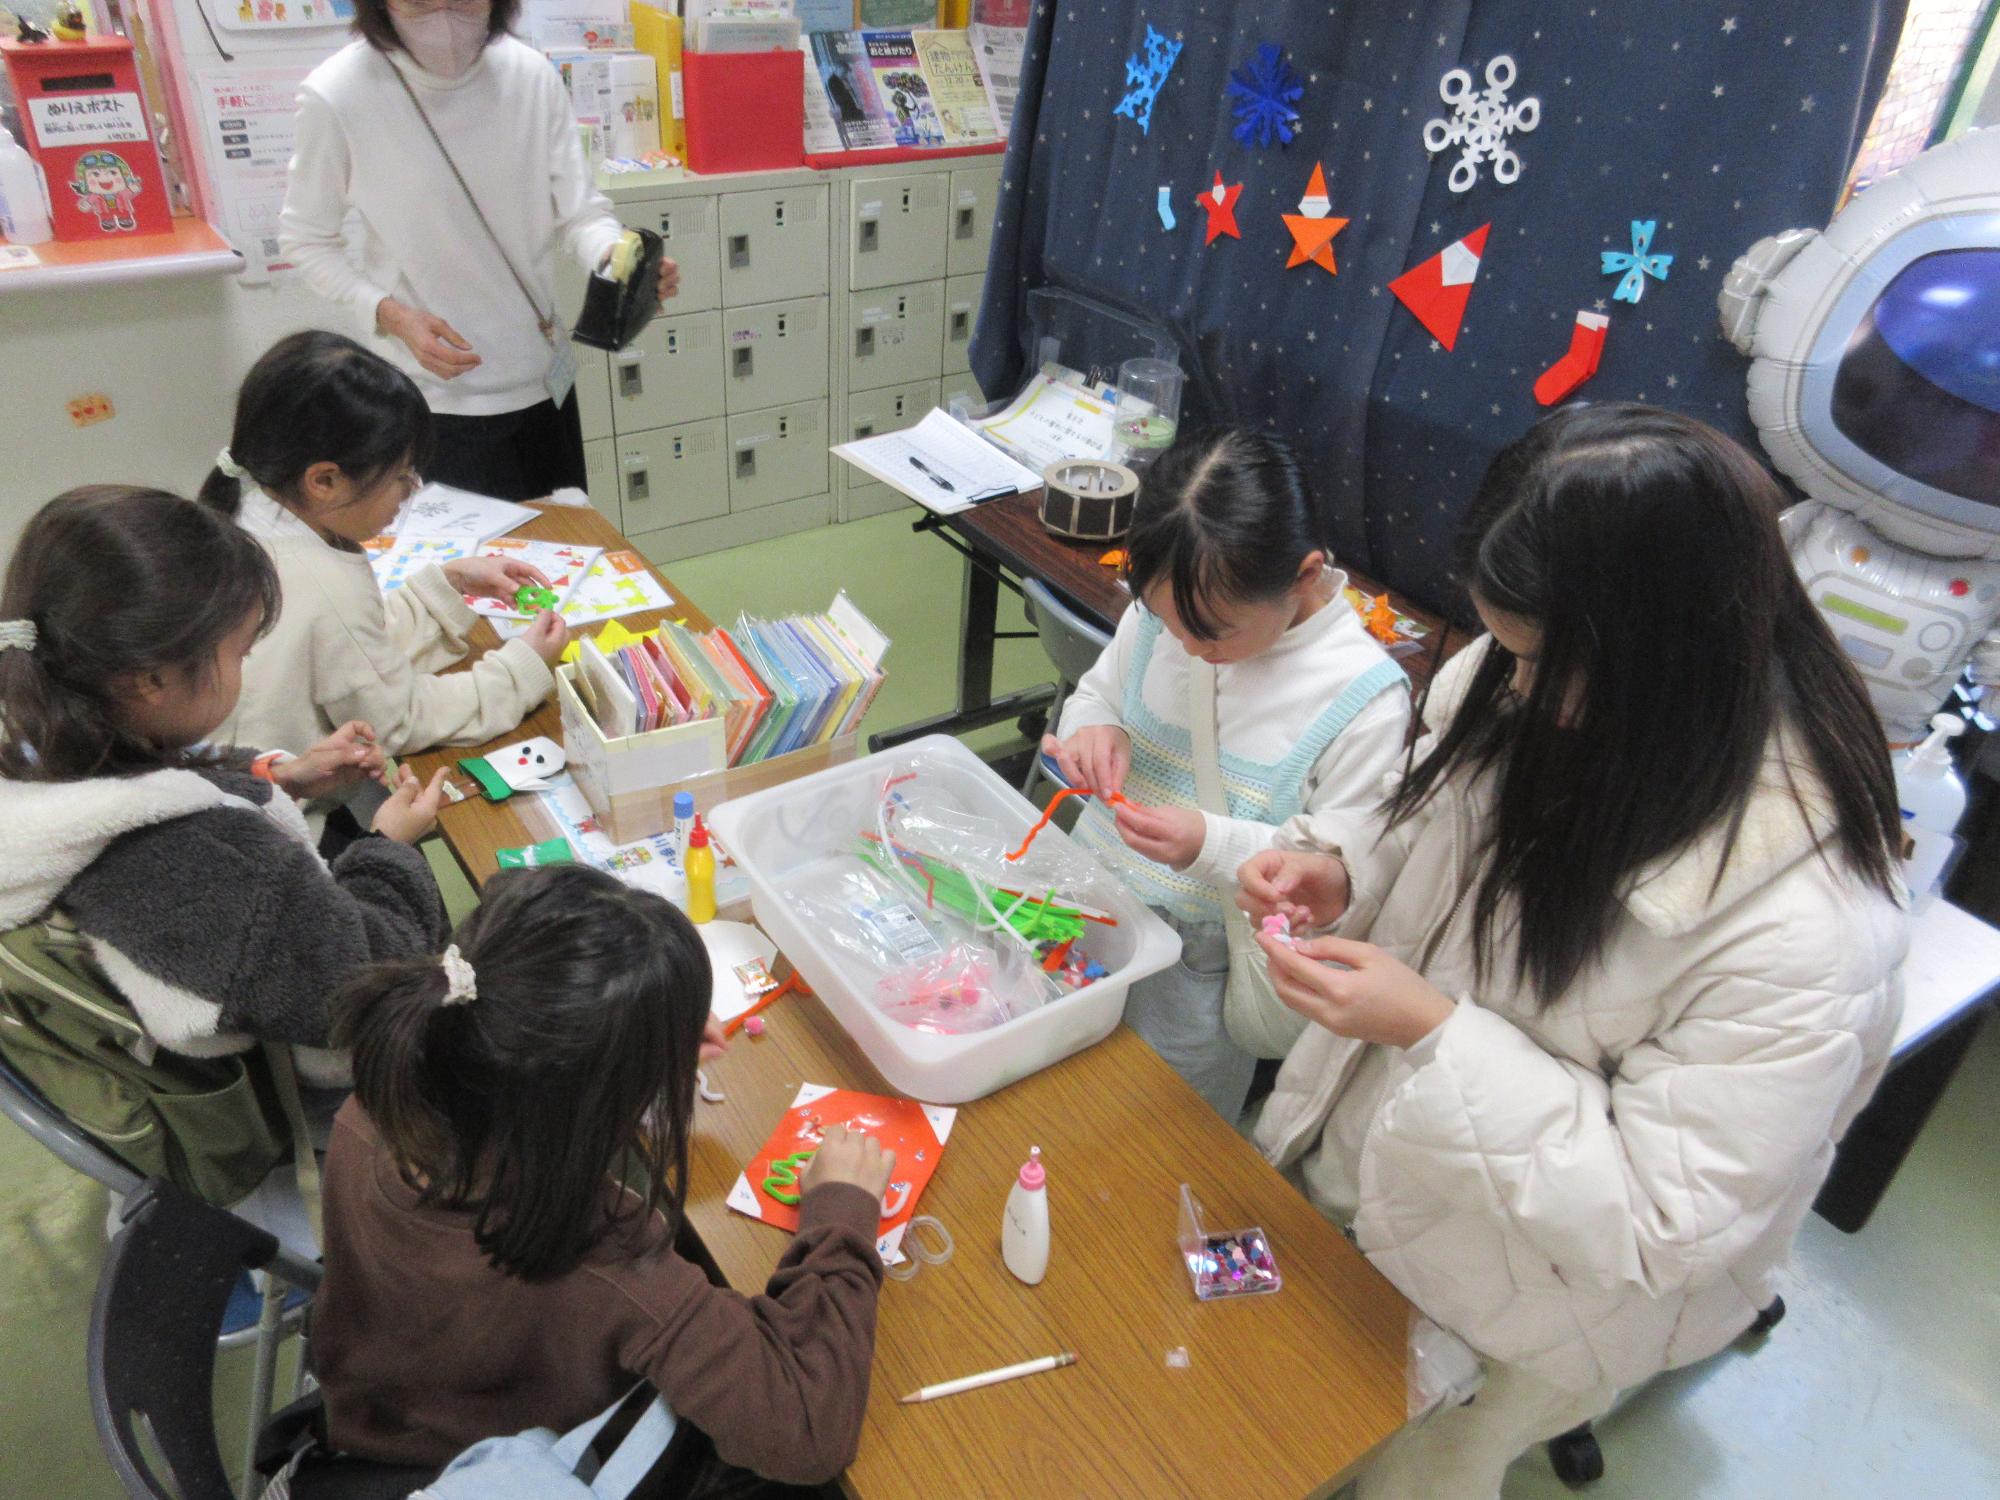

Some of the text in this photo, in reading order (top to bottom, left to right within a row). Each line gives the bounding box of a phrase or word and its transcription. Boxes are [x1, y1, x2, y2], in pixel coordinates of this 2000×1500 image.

[47, 97, 124, 117] ぬりえポスト
